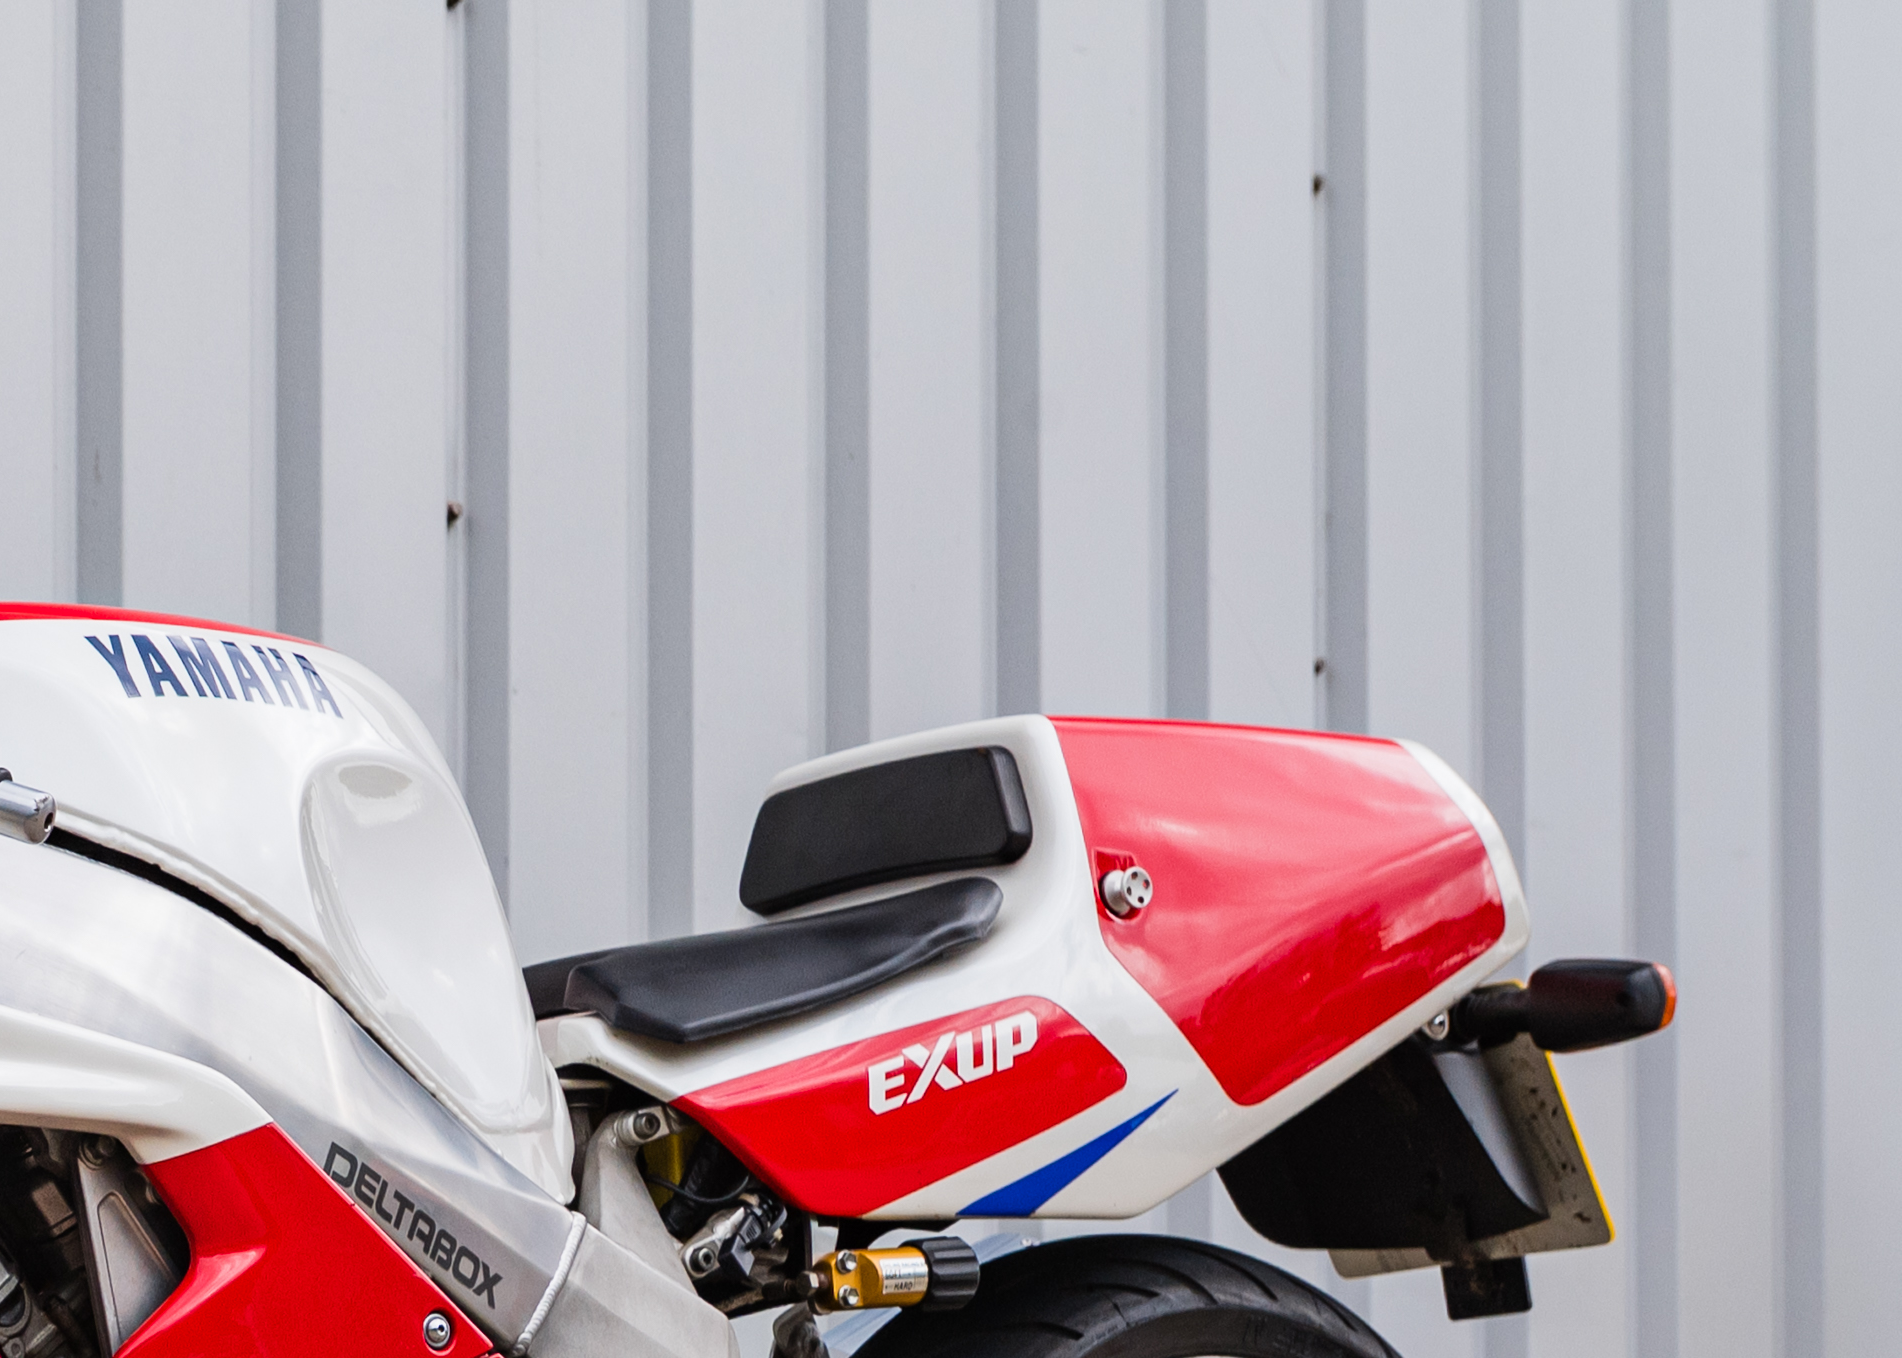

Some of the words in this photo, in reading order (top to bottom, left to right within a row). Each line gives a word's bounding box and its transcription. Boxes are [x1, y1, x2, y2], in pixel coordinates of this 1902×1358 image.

[84, 634, 344, 719] YAMAHA
[868, 1011, 1037, 1115] EXUP
[323, 1141, 503, 1309] DELTABOX
